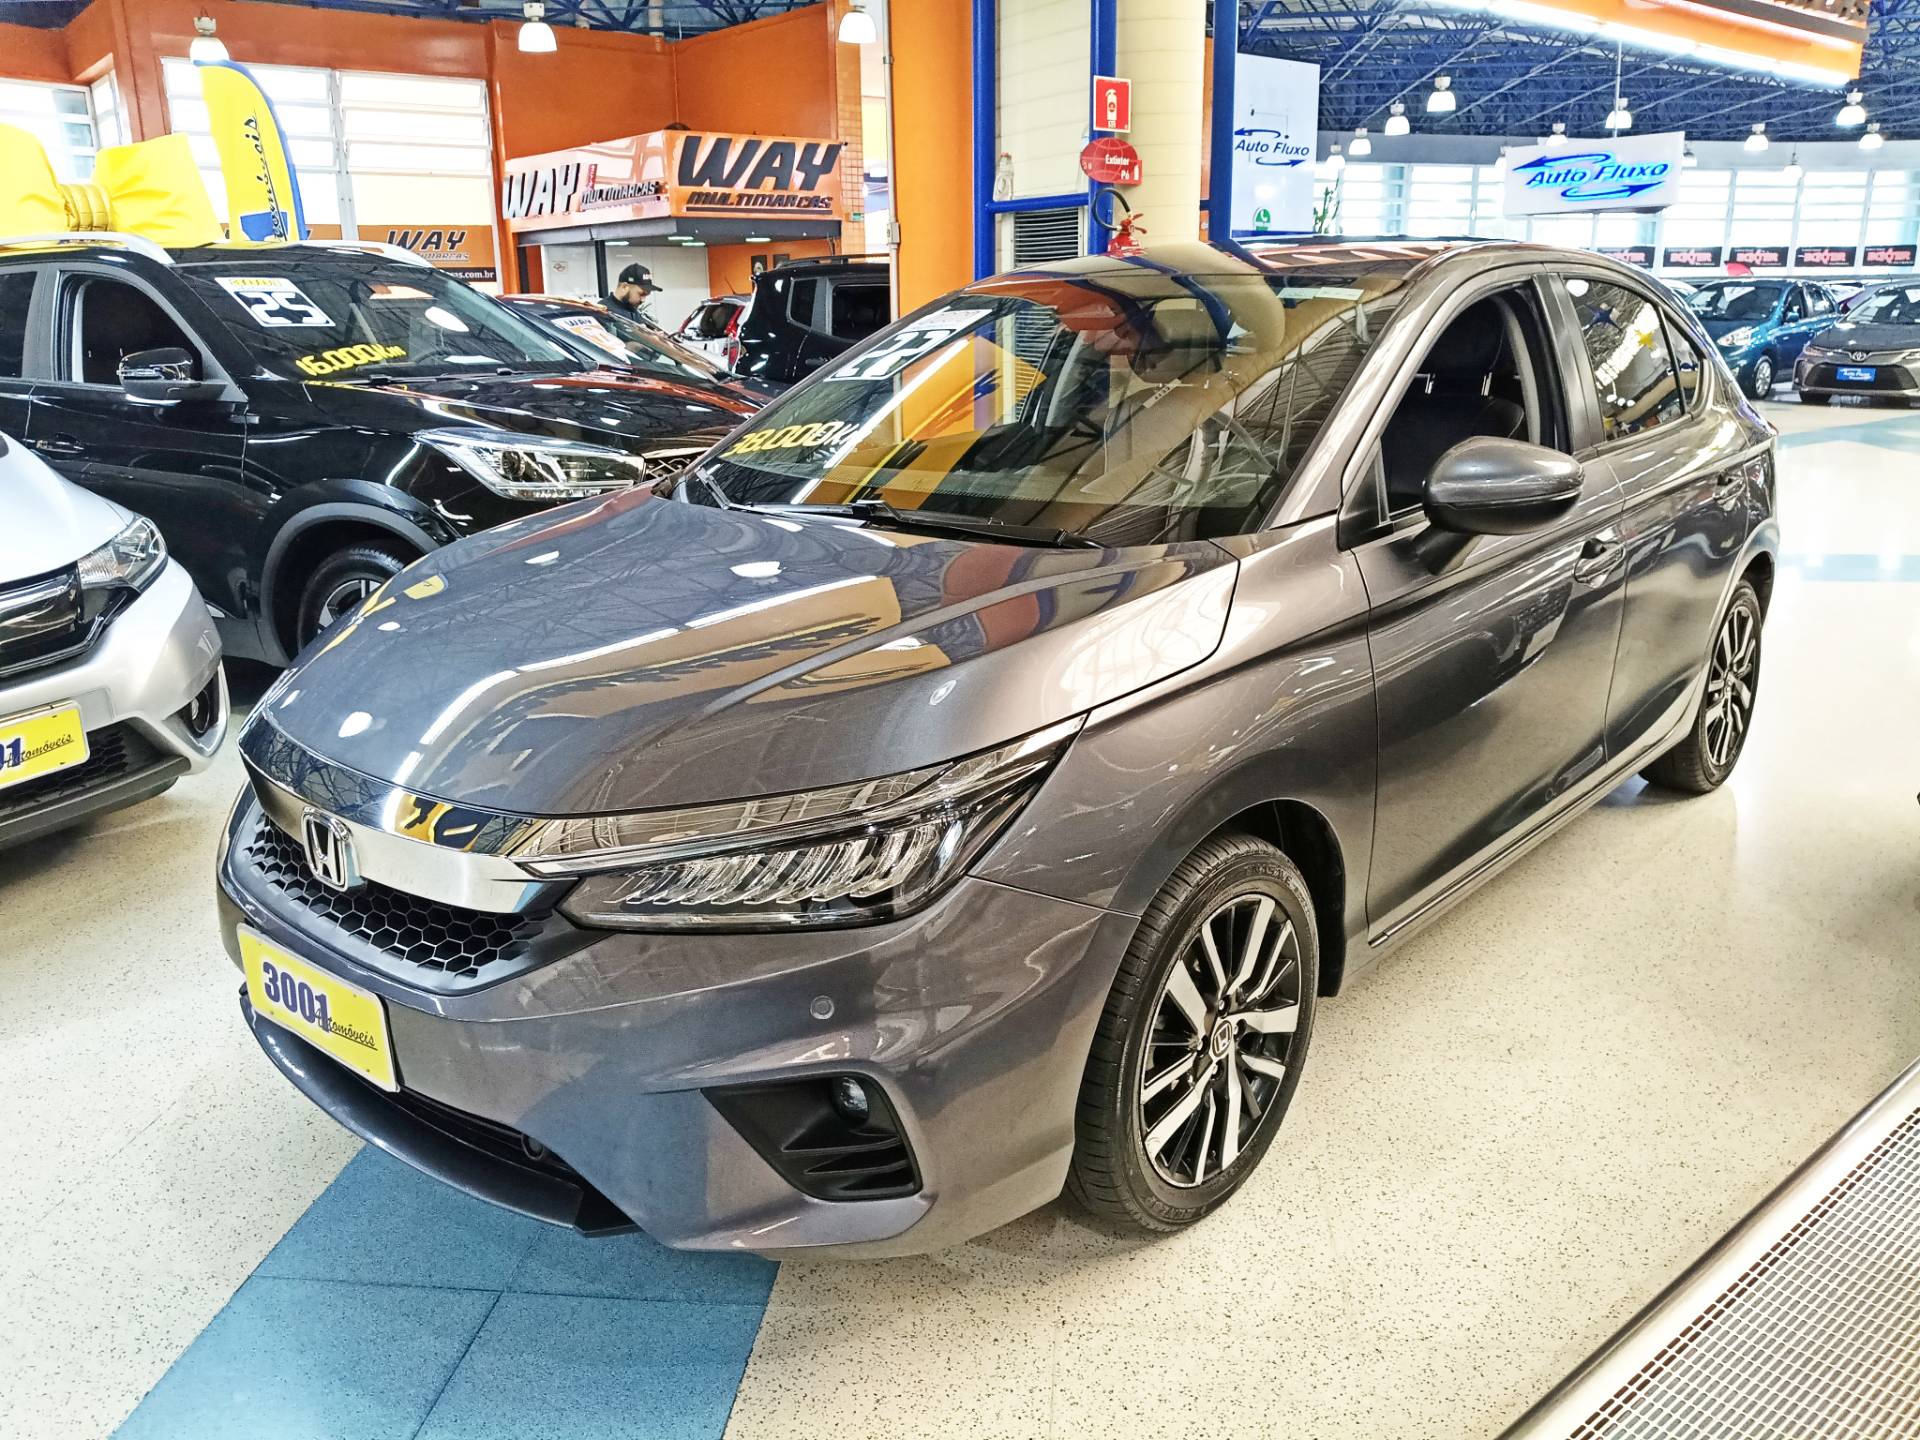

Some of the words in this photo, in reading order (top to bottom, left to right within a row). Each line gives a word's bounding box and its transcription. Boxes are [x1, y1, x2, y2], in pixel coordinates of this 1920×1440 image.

[1235, 139, 1269, 153] Auto
[1273, 142, 1310, 156] Fluxo
[678, 135, 842, 191] WAY
[1526, 168, 1588, 187] Auto
[1594, 162, 1670, 182] Fluxo
[502, 163, 581, 218] WAY
[686, 191, 833, 209] MULTIMARCAS
[387, 230, 466, 251] WAY
[234, 291, 330, 324] 25
[263, 961, 330, 1033] 3001
